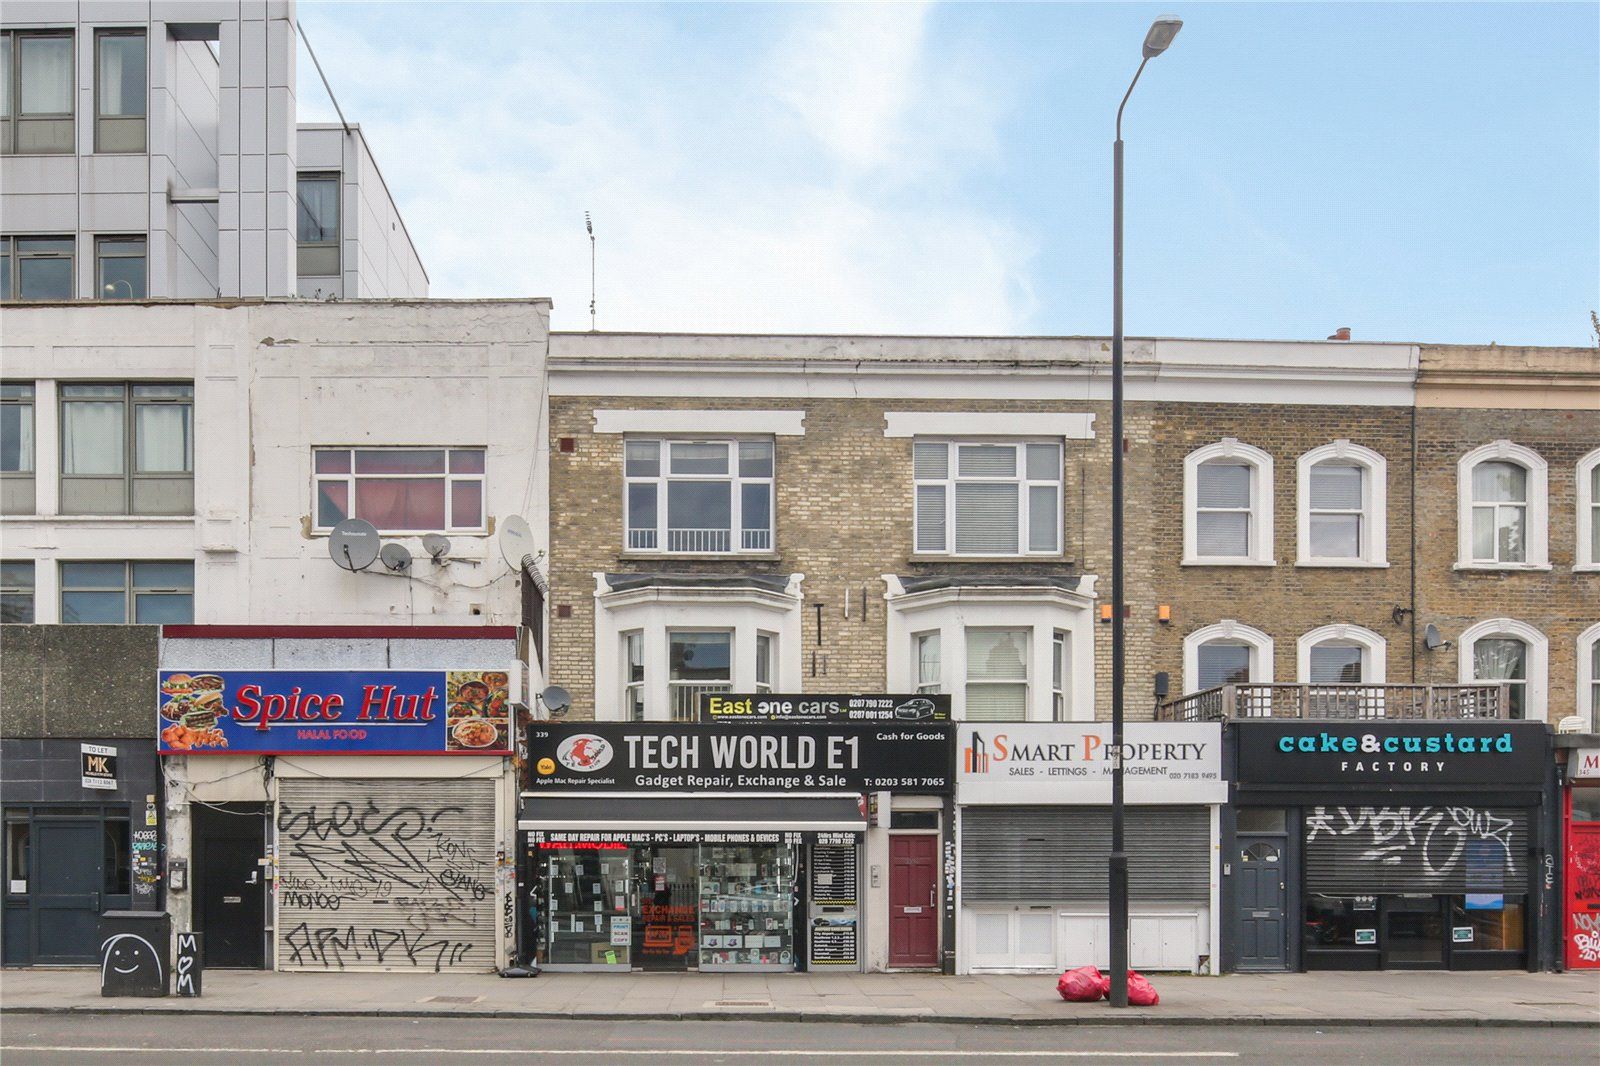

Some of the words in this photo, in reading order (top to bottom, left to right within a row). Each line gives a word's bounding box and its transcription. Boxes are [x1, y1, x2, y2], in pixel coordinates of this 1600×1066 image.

[232, 684, 344, 731] Spice
[356, 685, 439, 720] Hut
[710, 697, 752, 714] East
[798, 700, 840, 714] cars
[878, 699, 893, 708] 7222
[297, 730, 330, 740] HALAL
[333, 730, 367, 740] FOOD
[876, 732, 898, 741] Cash
[900, 732, 914, 741] for
[916, 732, 945, 741] Goods
[624, 735, 698, 769] TECH
[710, 735, 815, 769] WORLD
[827, 735, 858, 769] E1
[992, 734, 1075, 762] SMART
[1082, 734, 1207, 762] PROPERTY
[88, 756, 109, 773] MK
[1341, 762, 1445, 772] FACTORY
[1009, 767, 1034, 776] SALES
[1048, 767, 1087, 776] LETTINGS
[1102, 766, 1168, 776] MAGEMENT
[536, 778, 553, 786] Apple
[567, 778, 586, 786] Repair
[587, 778, 615, 786] Specialist
[635, 774, 683, 788] Gadget
[687, 774, 734, 788] Repair,
[738, 774, 800, 788] Exchange
[804, 775, 815, 786] &
[818, 774, 846, 786] Sale
[550, 833, 567, 842] SAME
[568, 833, 579, 842] DAY
[580, 833, 600, 842] REPAIR
[601, 833, 612, 842] FOR
[613, 833, 631, 842] APPLE
[632, 833, 650, 842] MAC'S
[705, 834, 726, 842] MOBILE
[727, 834, 749, 842] PHONES
[751, 834, 755, 842] &
[756, 834, 779, 842] DEVICES
